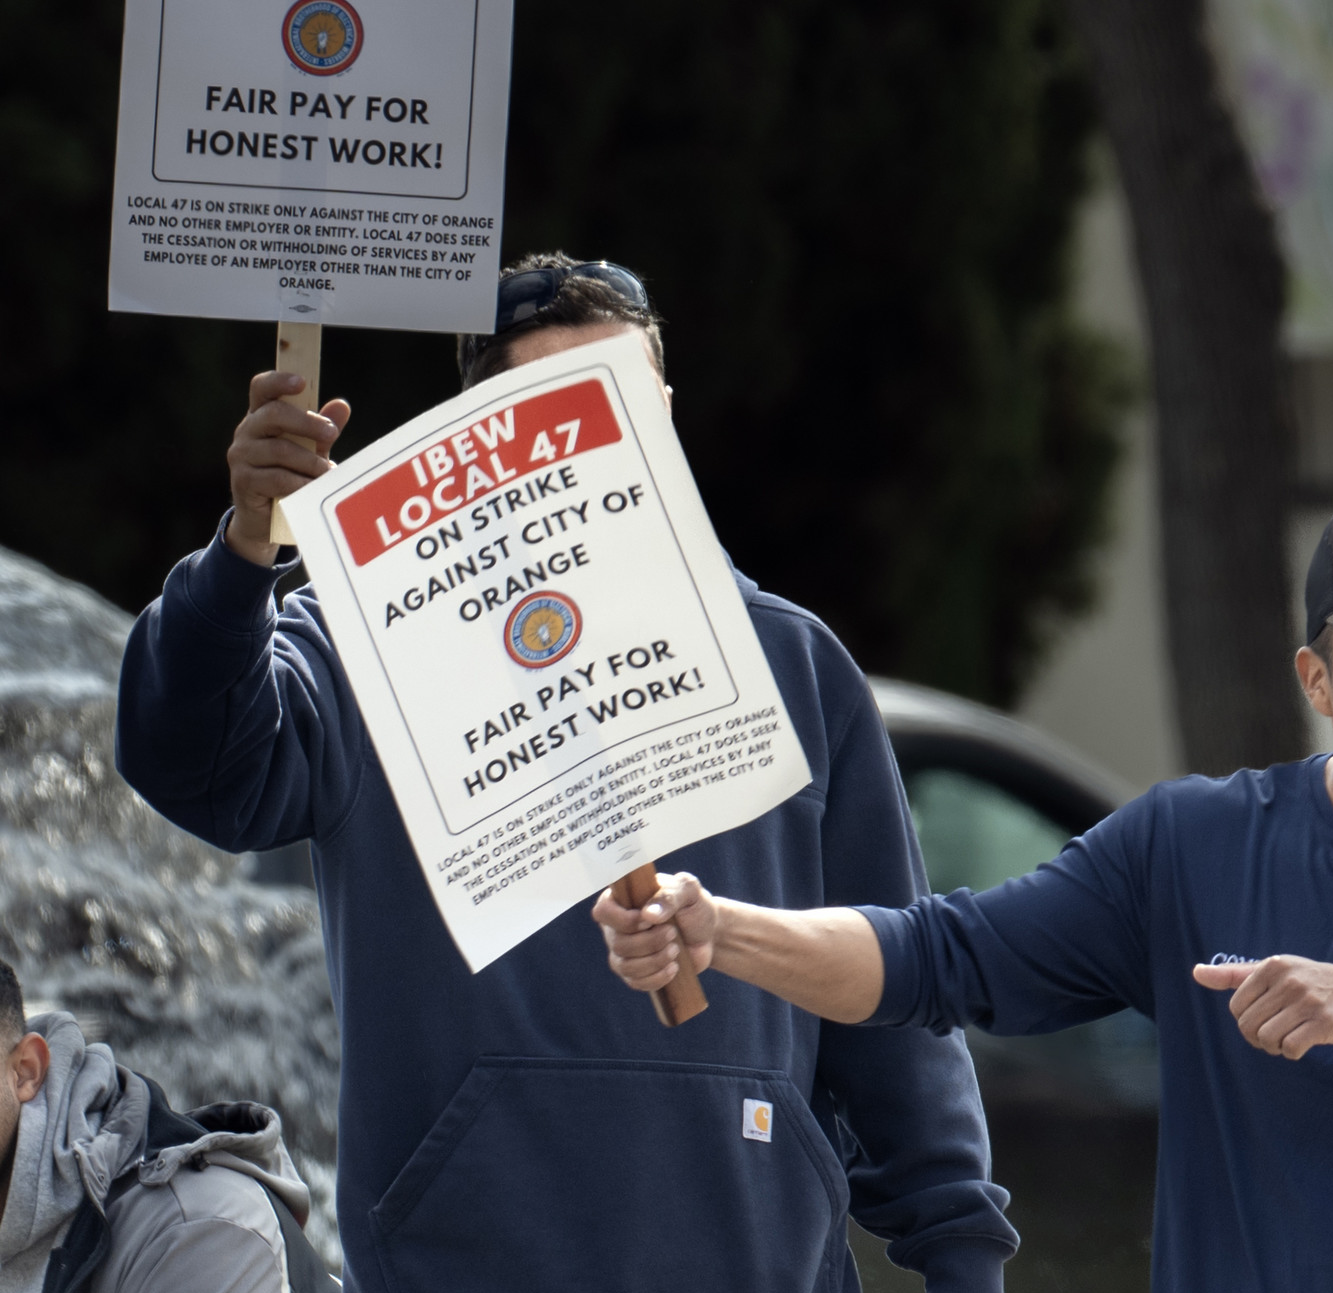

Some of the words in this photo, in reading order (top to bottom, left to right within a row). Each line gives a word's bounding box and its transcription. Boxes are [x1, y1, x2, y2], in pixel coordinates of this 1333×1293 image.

[205, 85, 277, 114] FAIR
[289, 91, 355, 119] PAY
[365, 96, 428, 124] FOR
[186, 128, 318, 160] HONEST
[328, 137, 442, 169] WORK!
[127, 195, 167, 209] LOCAL
[170, 198, 187, 210] 47
[190, 199, 201, 211] IS
[204, 200, 224, 212] ON
[227, 201, 269, 215] STRIKE
[273, 204, 306, 217] ONLY
[309, 206, 364, 221] AGAINST
[366, 210, 389, 222] THE
[391, 211, 419, 224] CITY
[421, 213, 438, 225] OF
[441, 215, 493, 229] ORANGE
[128, 214, 155, 226] AND
[158, 215, 178, 227] NO
[181, 216, 221, 230] OTHER
[225, 219, 289, 234] EMPLOYER
[293, 224, 311, 235] OR
[314, 225, 358, 238] ENTITY.
[362, 228, 402, 241] LOCAL
[405, 230, 422, 242] 47
[424, 231, 457, 244] DOES
[460, 234, 489, 246] SEEK
[141, 232, 163, 244] THE
[166, 233, 235, 249] CESSATION
[239, 238, 257, 250] OR
[260, 240, 347, 255] WITHHOLDING
[350, 245, 367, 256] OF
[370, 246, 427, 261] SERVICES
[431, 250, 447, 261] BY
[449, 251, 475, 263] ANY
[143, 250, 206, 265] EMPLOYEE
[210, 254, 227, 266] OF
[230, 256, 248, 267] AN
[252, 257, 316, 271] EMPLOYER
[319, 261, 359, 274] OTHER
[363, 263, 396, 276] THAN
[399, 265, 421, 278] THE
[424, 267, 452, 279] CITY
[454, 269, 471, 281] OF
[278, 276, 334, 290] ORANGE.
[411, 408, 516, 487] IBEW
[376, 453, 516, 546] LOCAL
[530, 419, 580, 461] 47
[415, 520, 462, 559] ON
[470, 465, 577, 531] STRIKE
[385, 534, 509, 627] AGAINST
[521, 500, 588, 544] CITY
[602, 484, 643, 513] OF
[459, 543, 589, 621] ORANGE
[463, 702, 532, 753] FAIR
[536, 661, 594, 711] PAY
[606, 640, 674, 676] FOR
[463, 712, 578, 797] HONEST
[586, 667, 704, 724] WORK!
